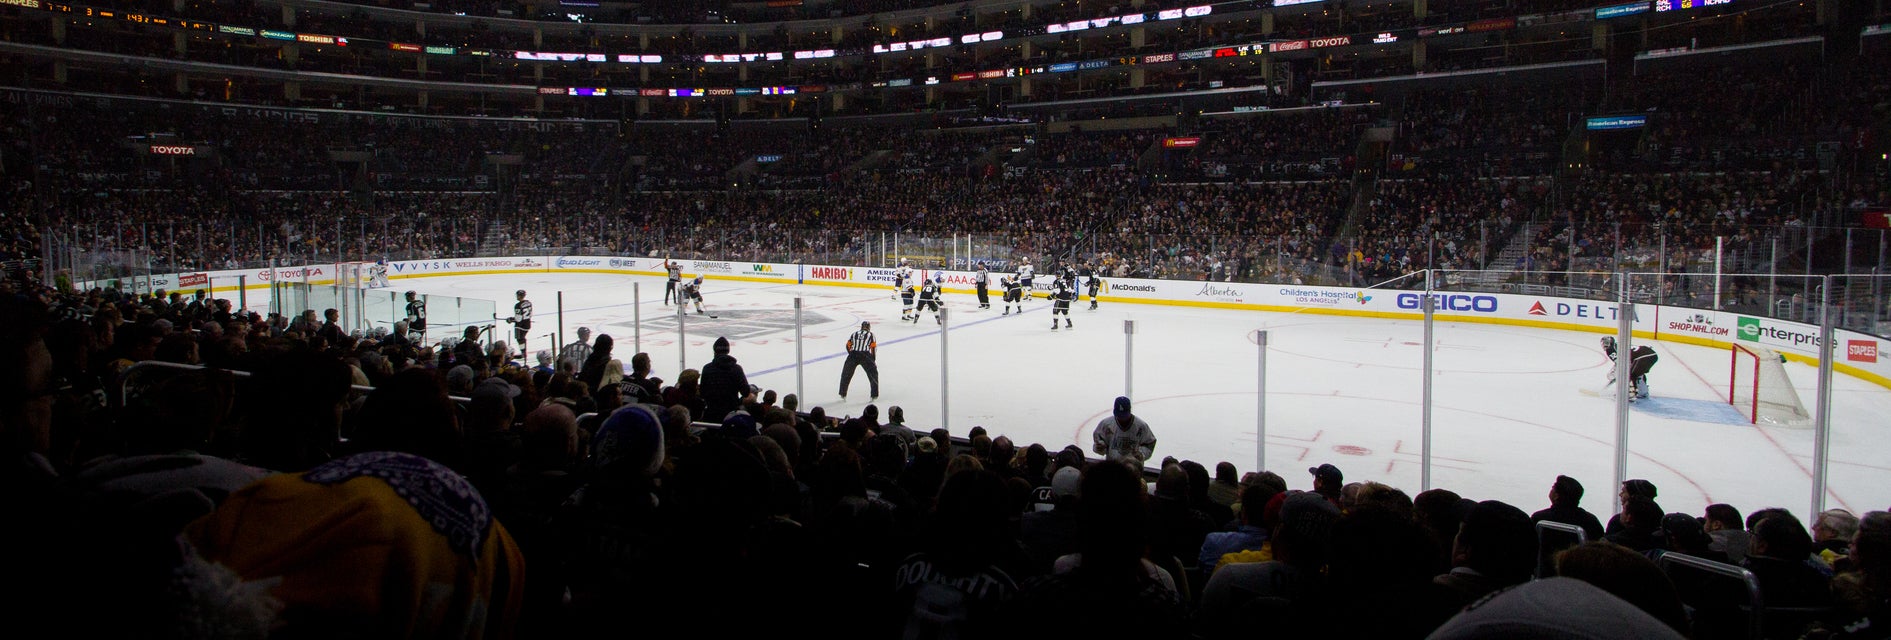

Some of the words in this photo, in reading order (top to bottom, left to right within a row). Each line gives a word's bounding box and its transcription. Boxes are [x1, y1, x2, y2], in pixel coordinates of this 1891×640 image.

[297, 34, 334, 44] TOSHIBA
[1310, 37, 1350, 48] TOYOTA
[1145, 54, 1173, 63] STAPLES
[977, 70, 1005, 79] TOSHIBA
[151, 146, 195, 155] TOYOTA
[410, 261, 450, 270] VYSK
[484, 260, 512, 268] FARGO
[558, 259, 578, 267] BUD
[578, 258, 600, 267] LIGHT
[976, 259, 1007, 267] LGHT
[280, 267, 323, 276] TOYOTA
[753, 264, 773, 273] WM
[812, 267, 847, 281] HARIBO
[179, 277, 206, 286] STAPLES
[1111, 283, 1156, 293] McDonald's
[1279, 288, 1319, 298] Children's
[1320, 290, 1357, 303] Hospital
[1397, 293, 1498, 314] GEICO
[1669, 322, 1729, 337] SHOP.NHL.COM
[1849, 345, 1876, 357] STAPLES
[895, 560, 1013, 608] DOUHTY
